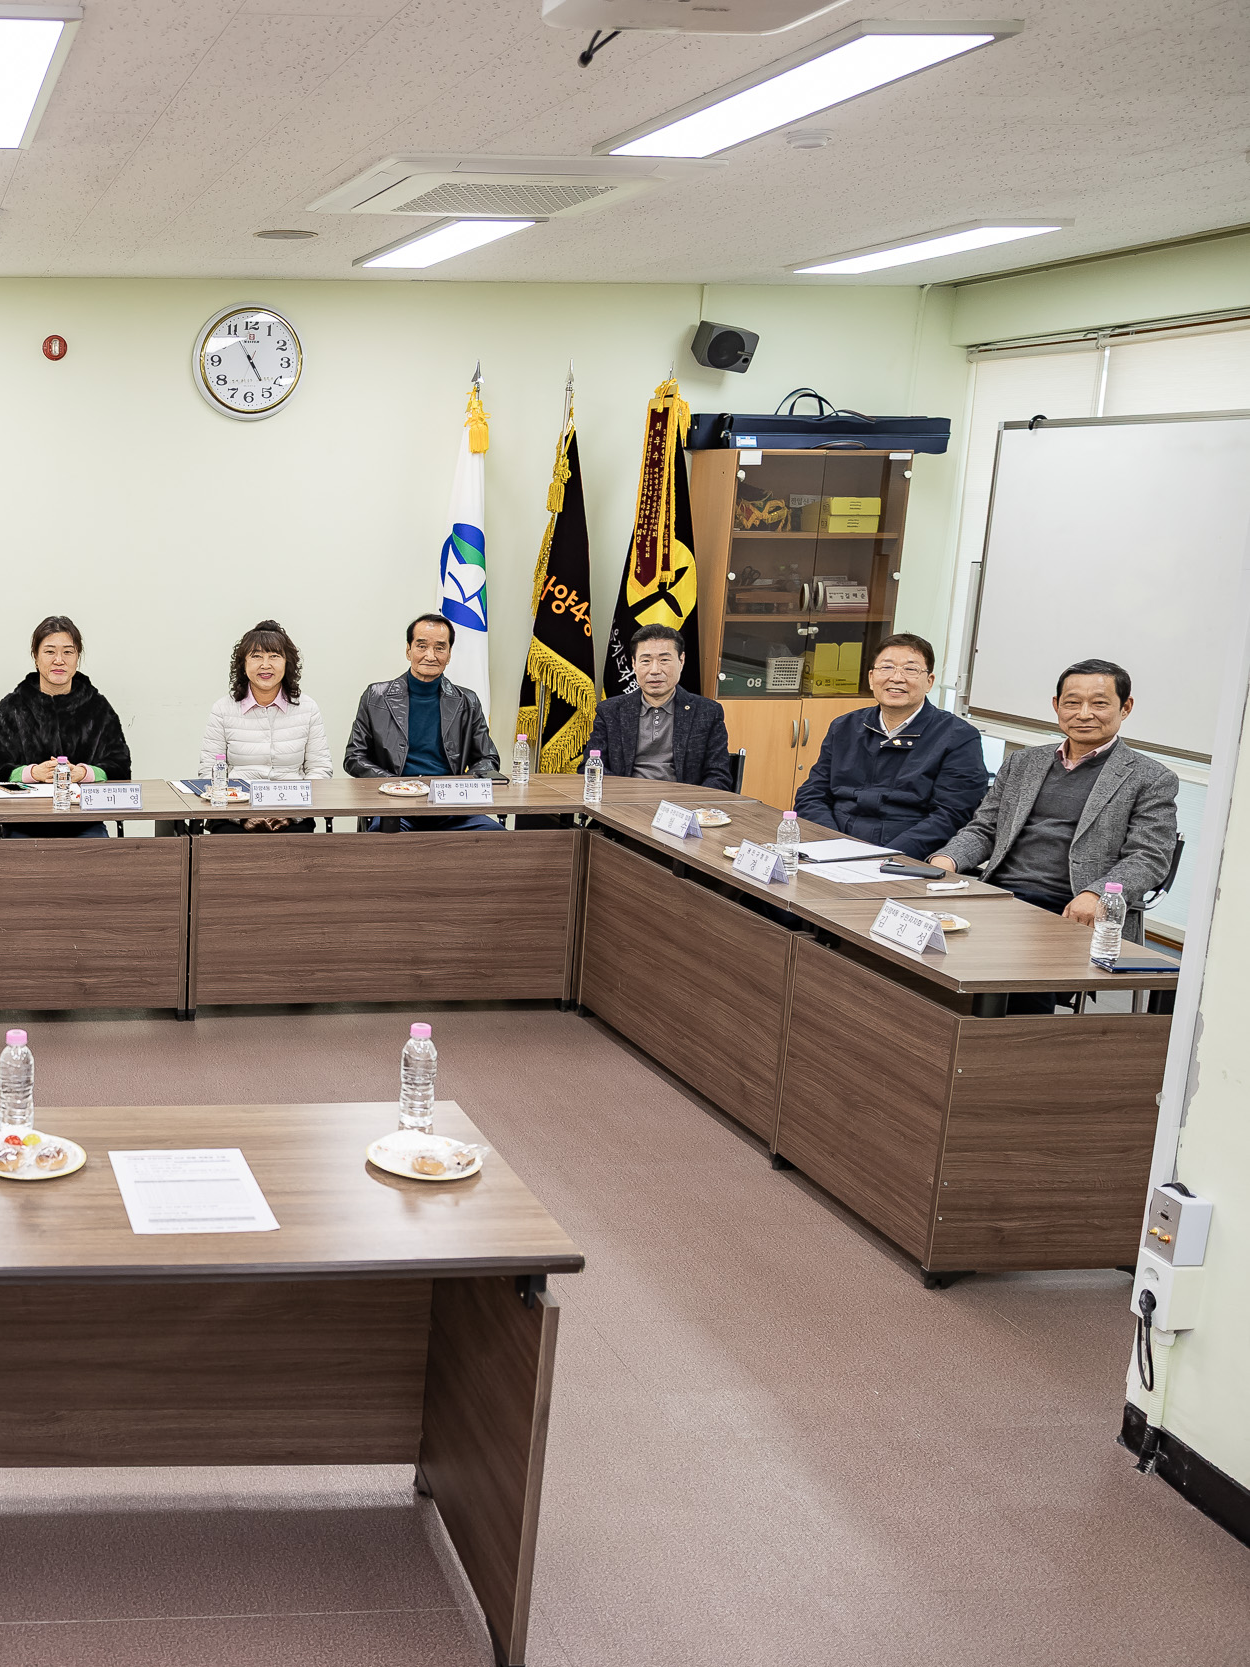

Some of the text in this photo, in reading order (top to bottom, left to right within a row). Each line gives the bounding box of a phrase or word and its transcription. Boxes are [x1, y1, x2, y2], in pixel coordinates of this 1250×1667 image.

[244, 321, 260, 331] 12
[267, 324, 272, 336] 1
[276, 339, 288, 351] 2
[210, 354, 222, 367] 9
[279, 356, 291, 368] 3
[216, 374, 228, 386] 8
[227, 387, 239, 399] 7
[243, 391, 255, 403] 6
[261, 386, 273, 399] 5
